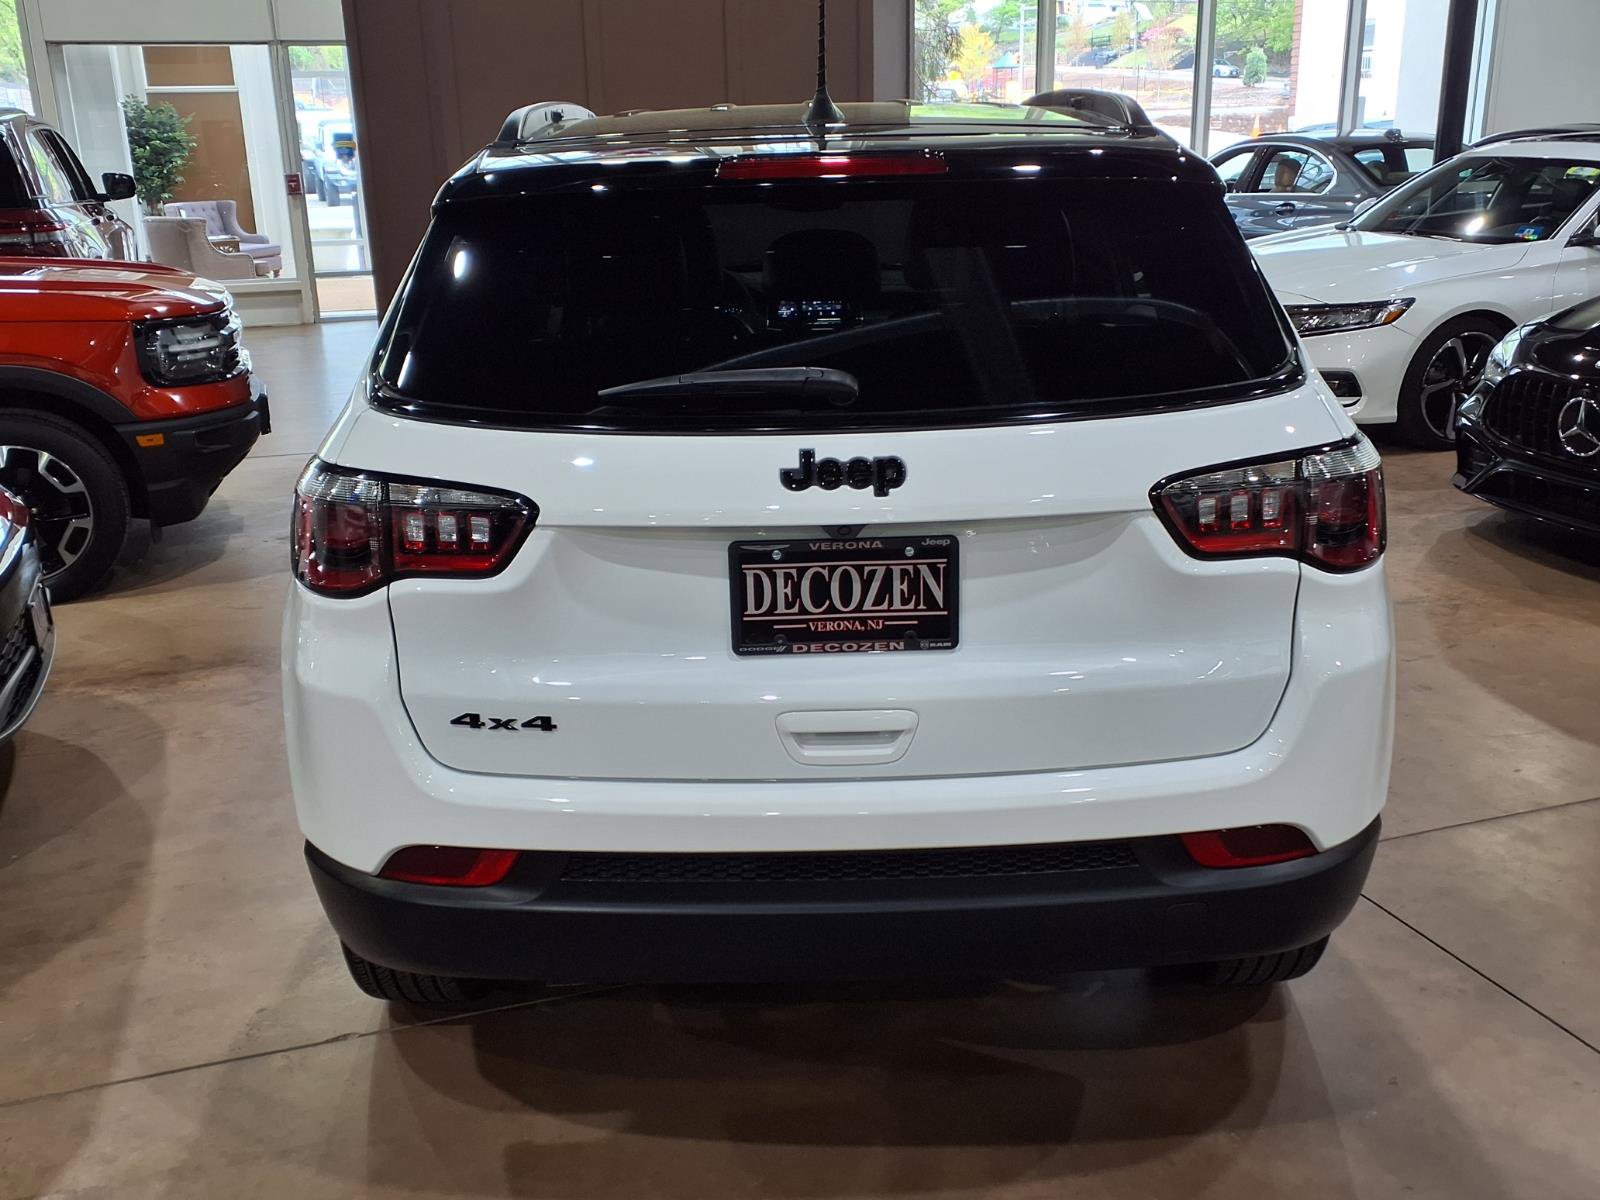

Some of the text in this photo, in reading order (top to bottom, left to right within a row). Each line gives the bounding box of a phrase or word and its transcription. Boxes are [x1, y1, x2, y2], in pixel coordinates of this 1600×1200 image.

[780, 448, 907, 497] Jeep
[808, 540, 882, 550] VERONA
[921, 538, 951, 547] Jeep
[743, 563, 947, 615] DECOZEN
[808, 619, 884, 632] VERONA, NJ
[792, 641, 905, 653] DECOZEN
[450, 713, 557, 731] 4x4
